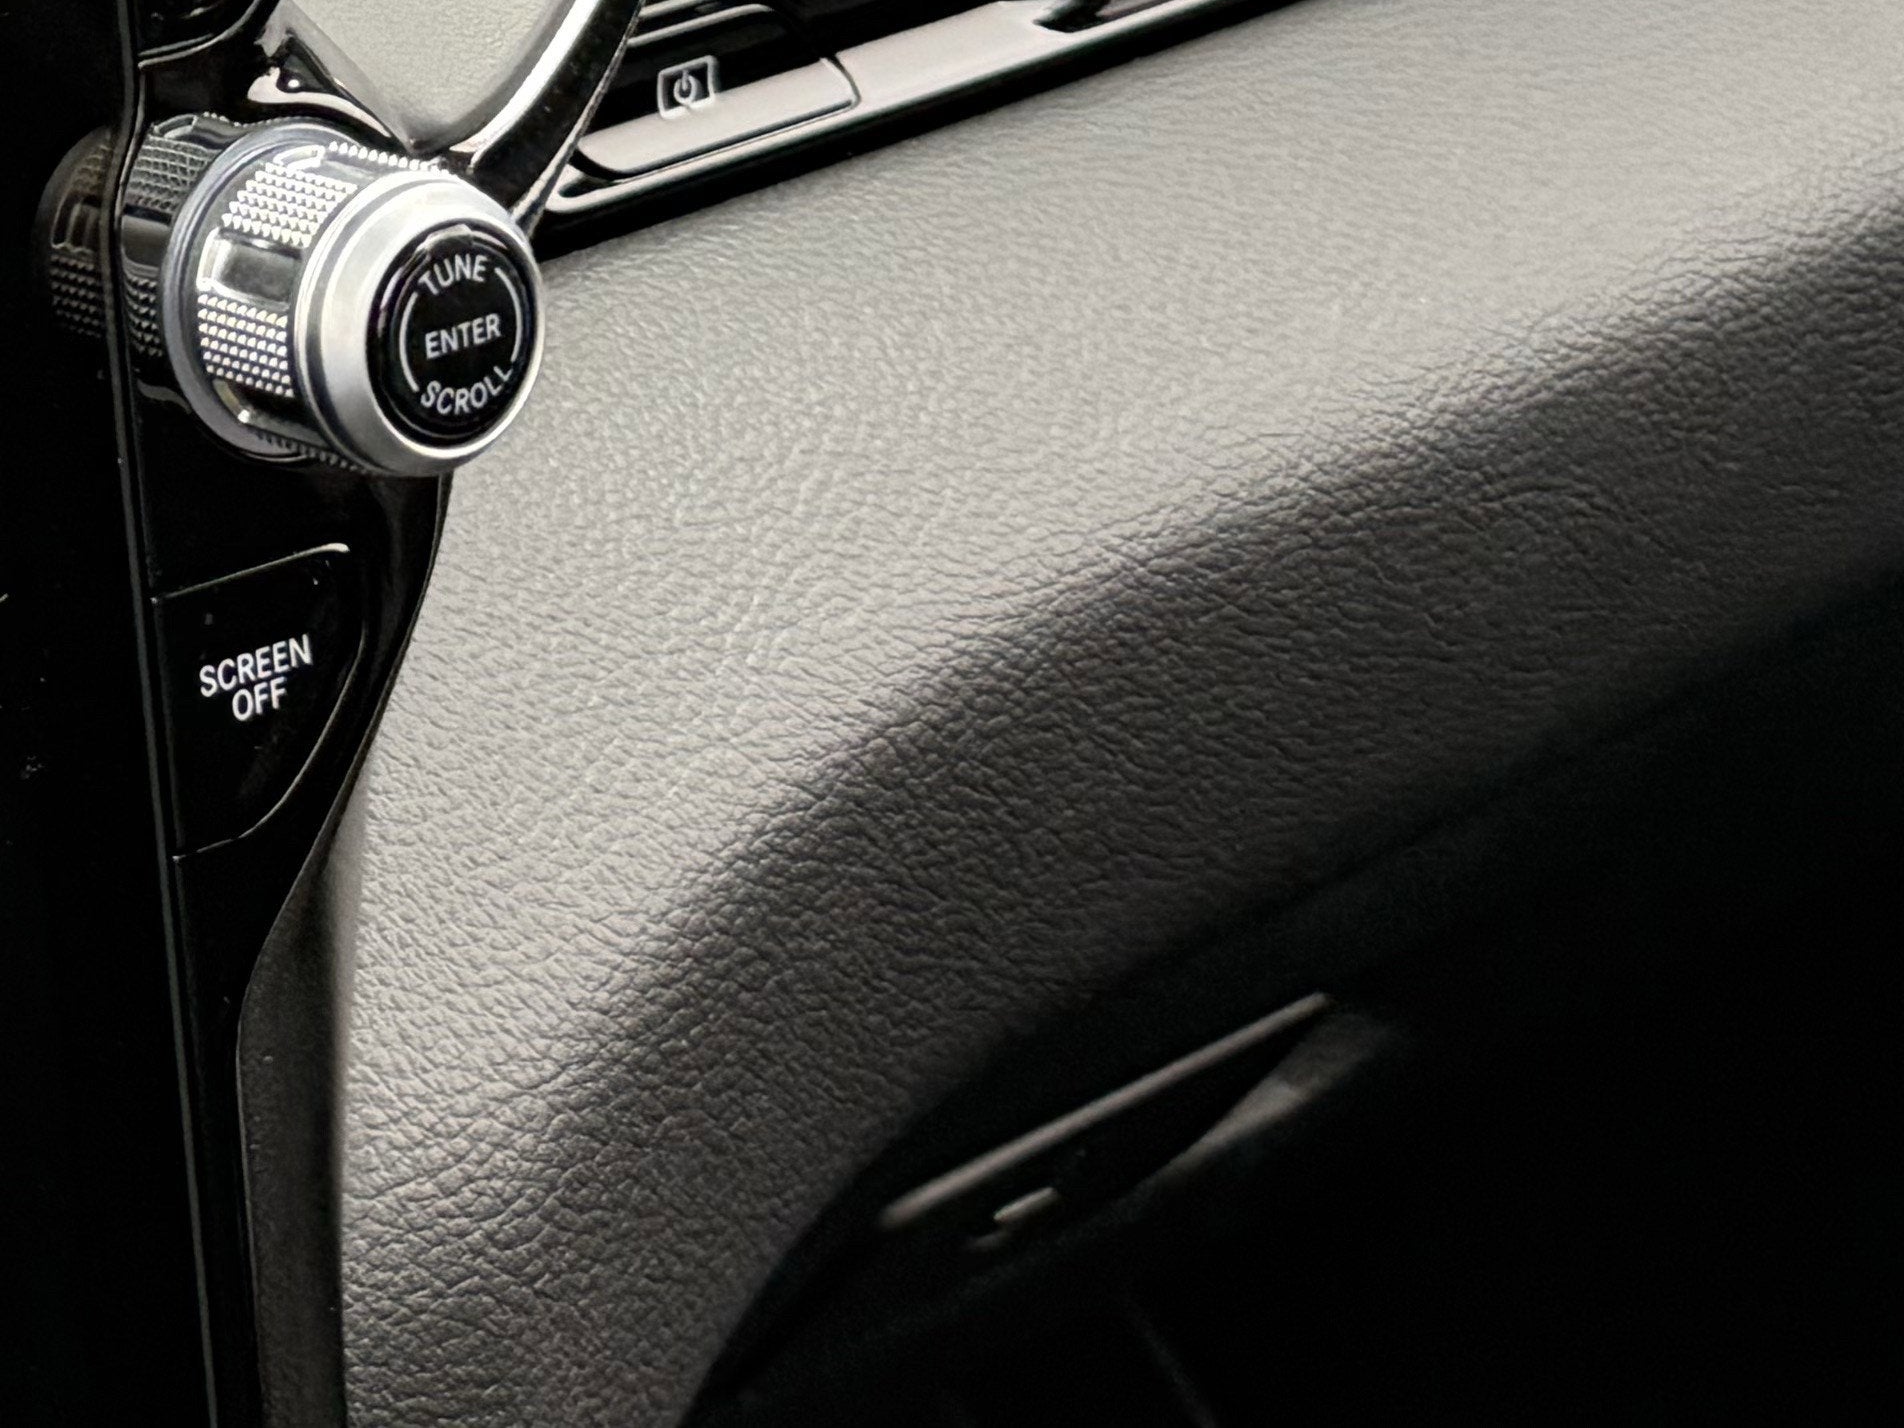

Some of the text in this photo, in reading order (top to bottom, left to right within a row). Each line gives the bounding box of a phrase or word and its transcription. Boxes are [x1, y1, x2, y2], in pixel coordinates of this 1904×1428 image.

[418, 253, 489, 296] TUNE
[425, 313, 501, 359] ENTER
[421, 365, 513, 415] SCROLL
[199, 633, 313, 698] SCREEN
[232, 676, 288, 722] OFF
